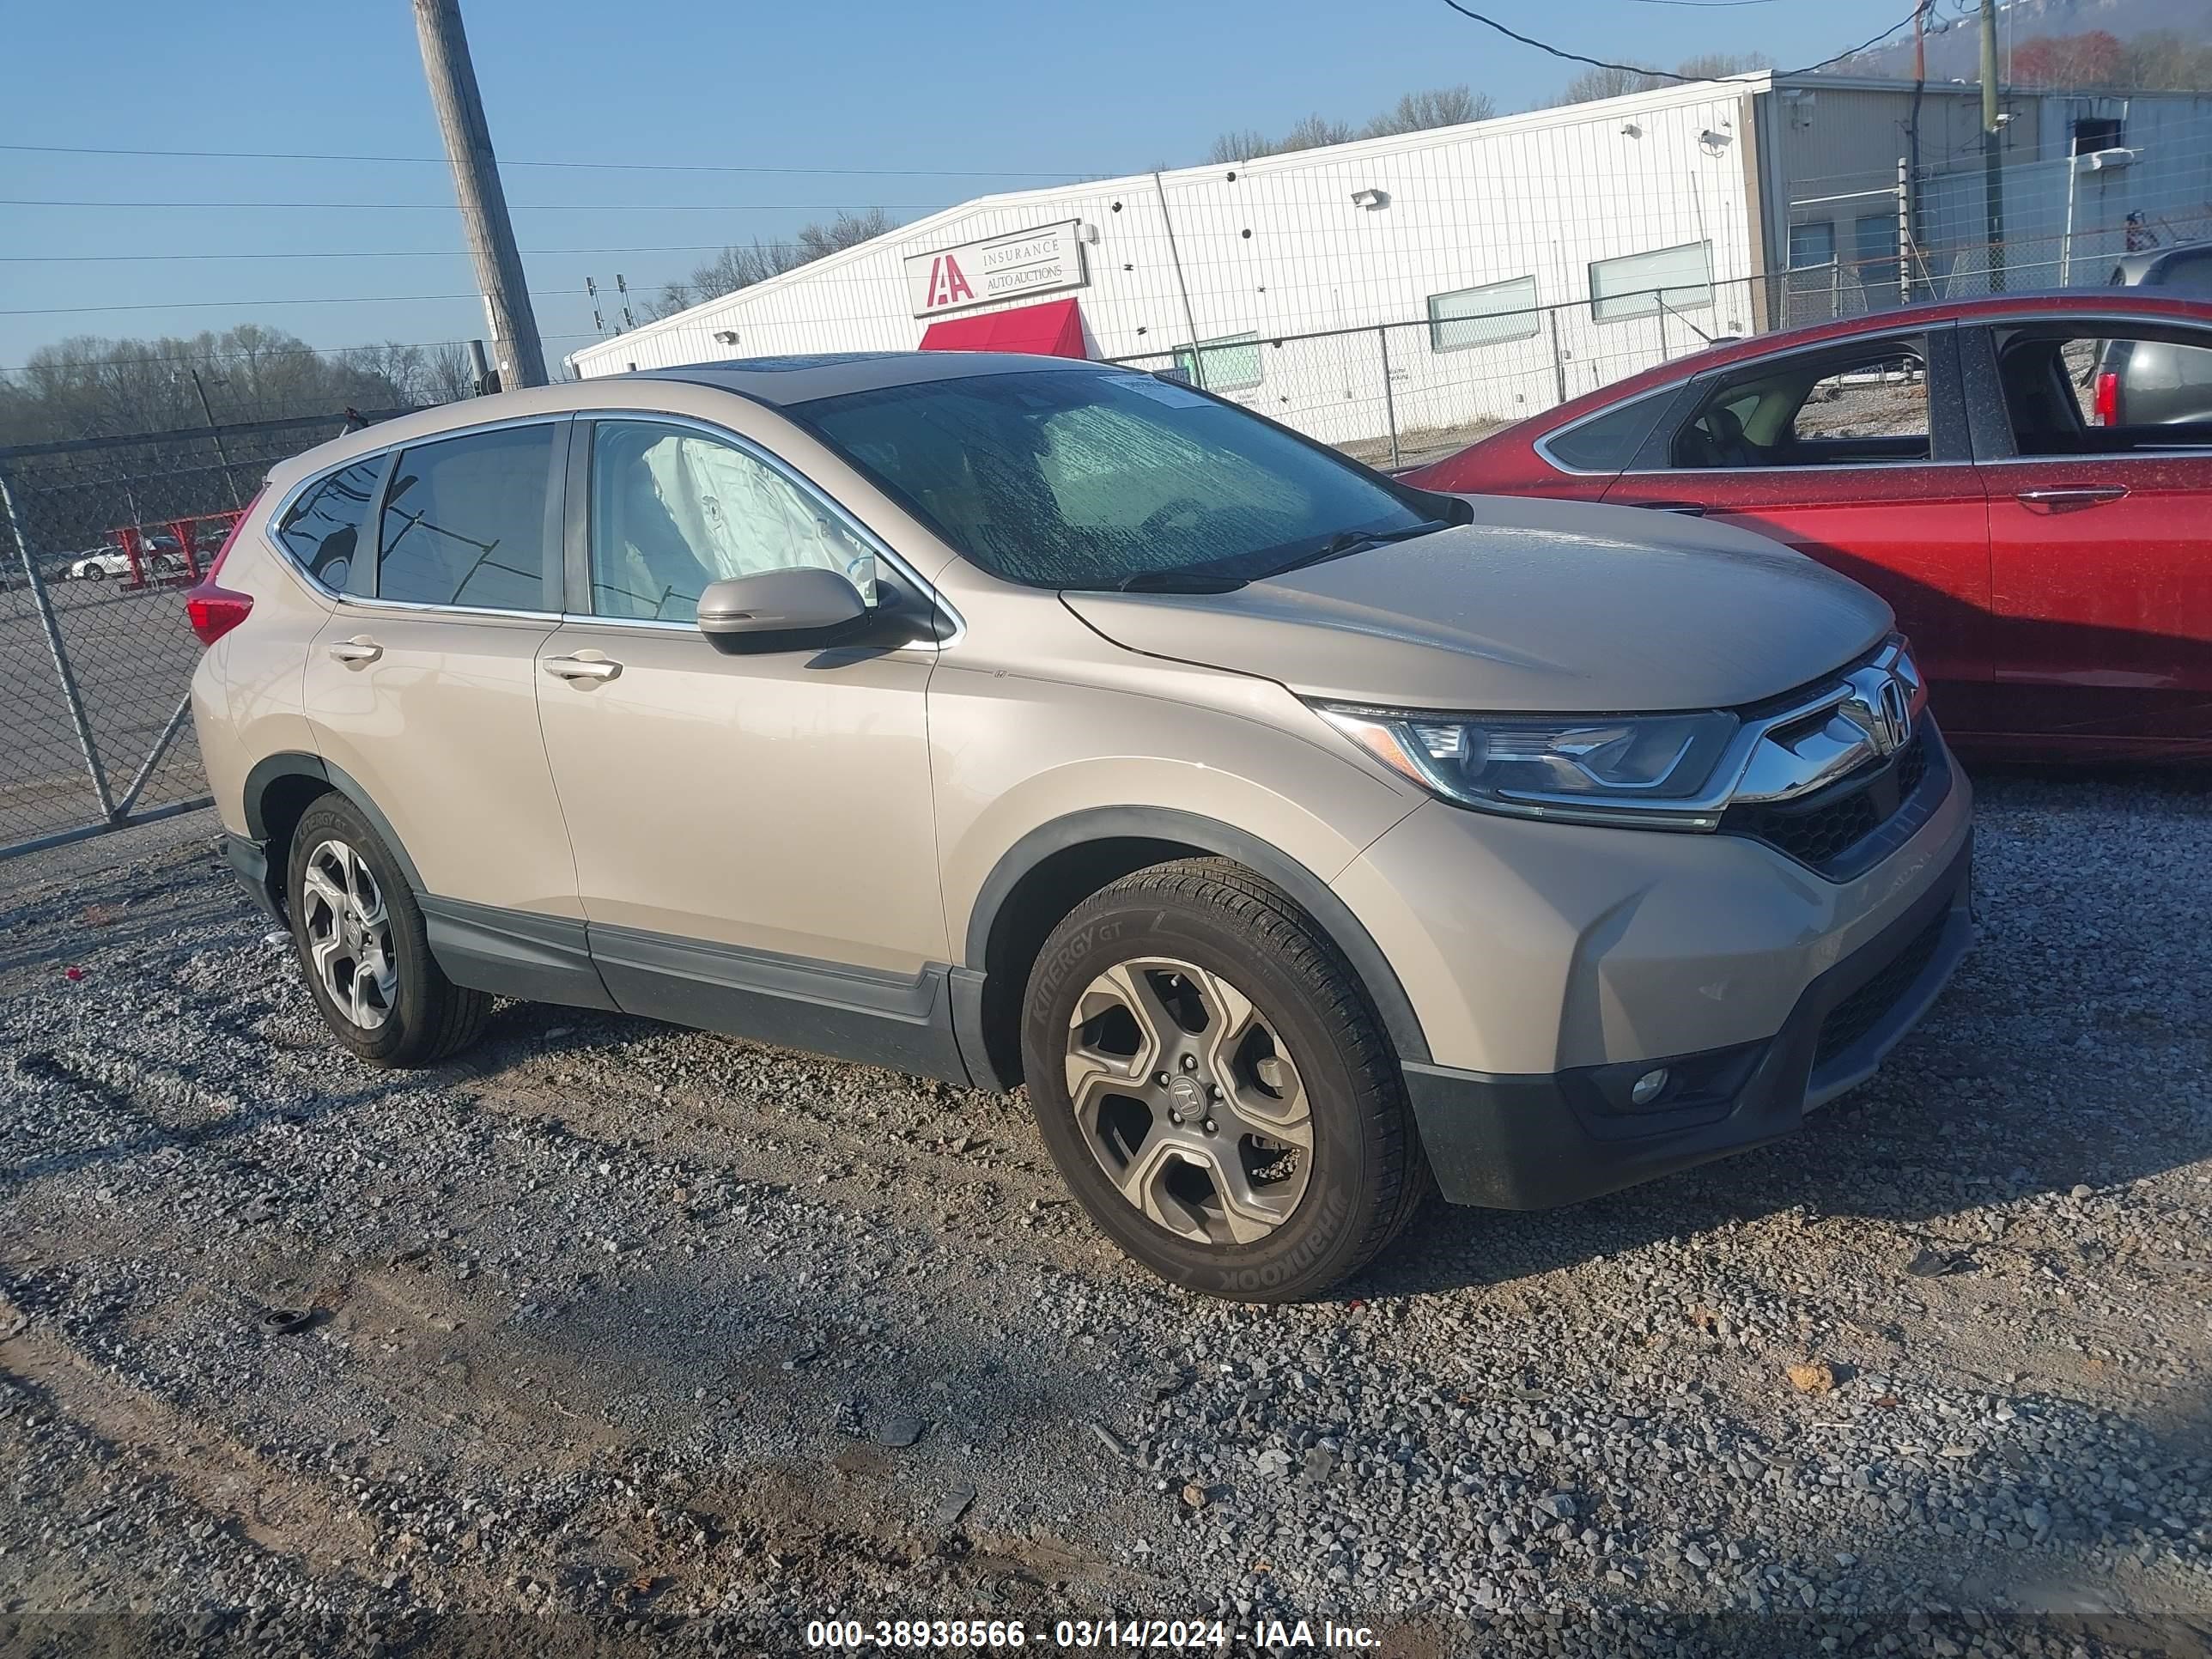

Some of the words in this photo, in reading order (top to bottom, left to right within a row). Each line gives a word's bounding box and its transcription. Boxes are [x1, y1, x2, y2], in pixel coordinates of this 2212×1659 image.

[983, 240, 1060, 266] INSURANCE
[988, 275, 1013, 290] AUTO
[1013, 264, 1063, 284] AUCTIONS
[1032, 927, 1094, 1024] KINERGY
[1098, 921, 1123, 941] GT
